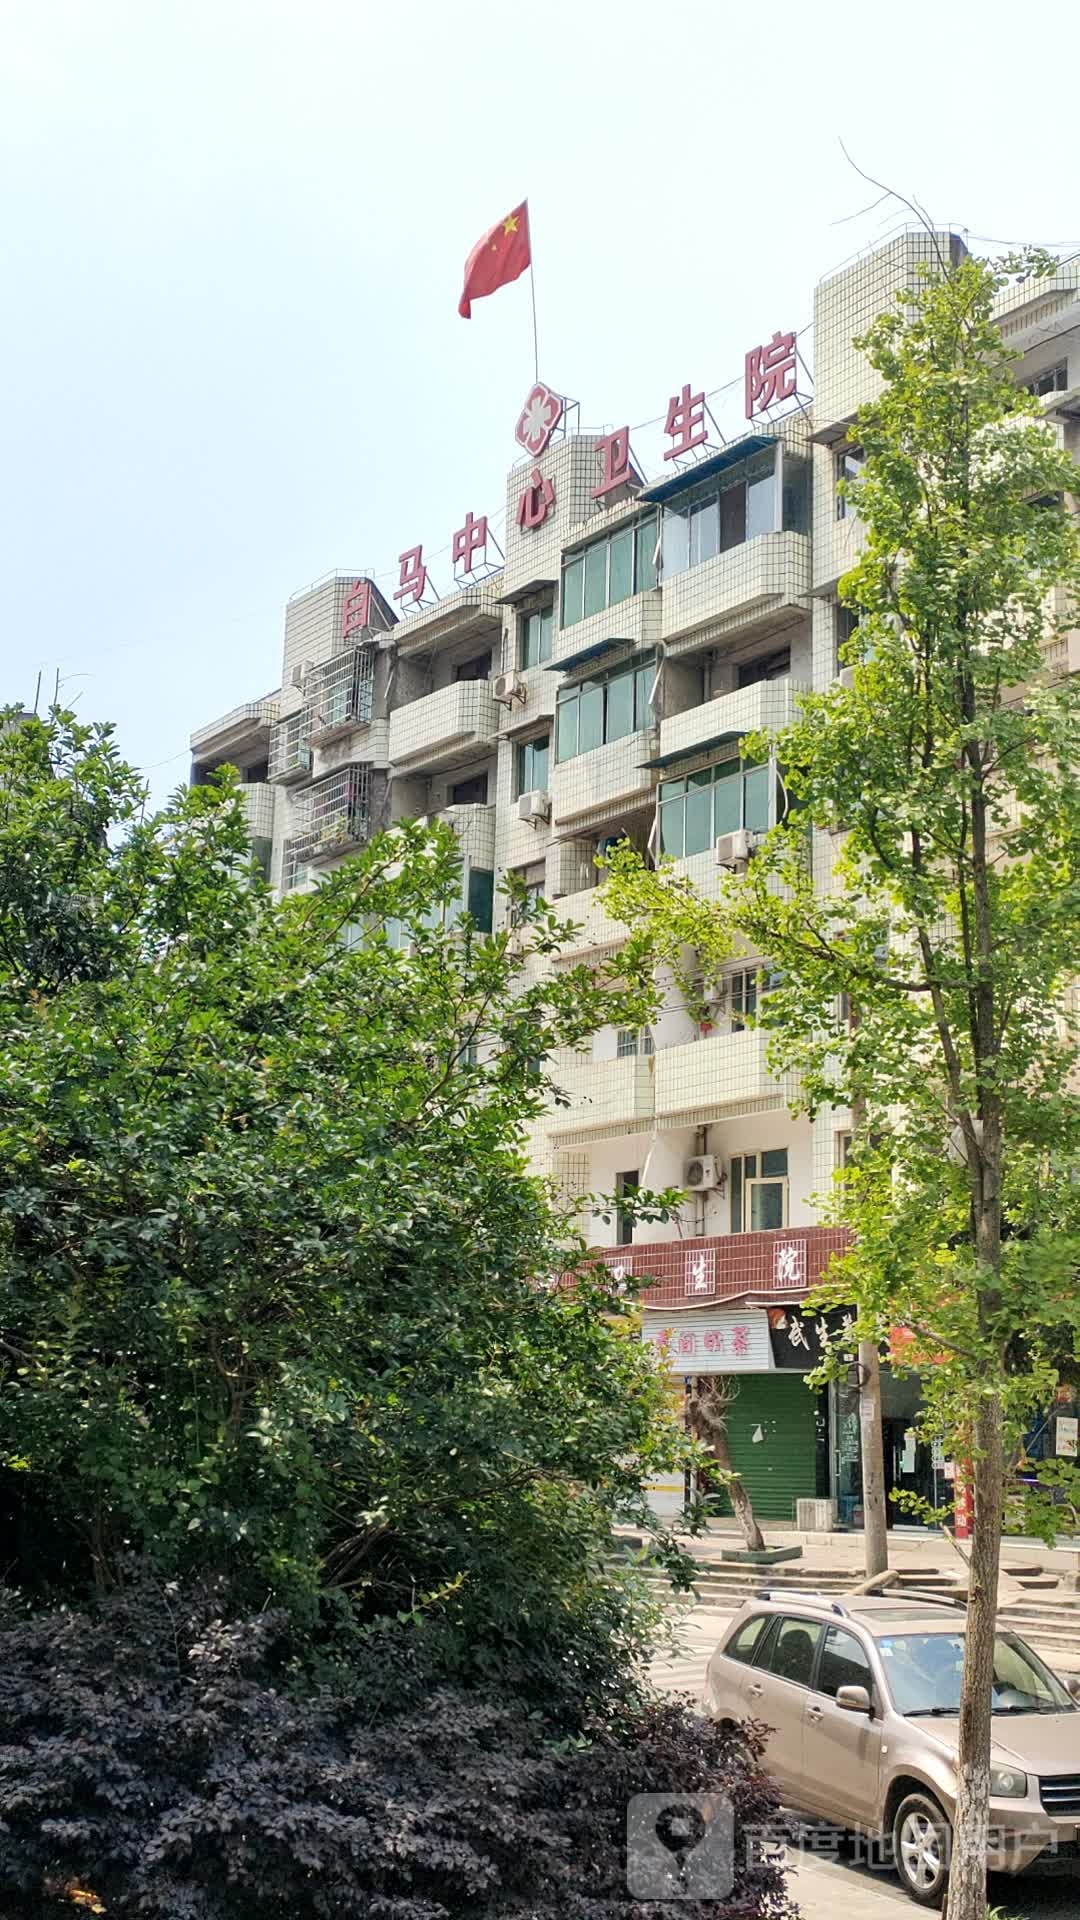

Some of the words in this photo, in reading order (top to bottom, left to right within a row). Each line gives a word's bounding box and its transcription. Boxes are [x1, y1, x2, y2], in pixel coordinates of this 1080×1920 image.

[342, 331, 797, 639] 白马中心卫生院
